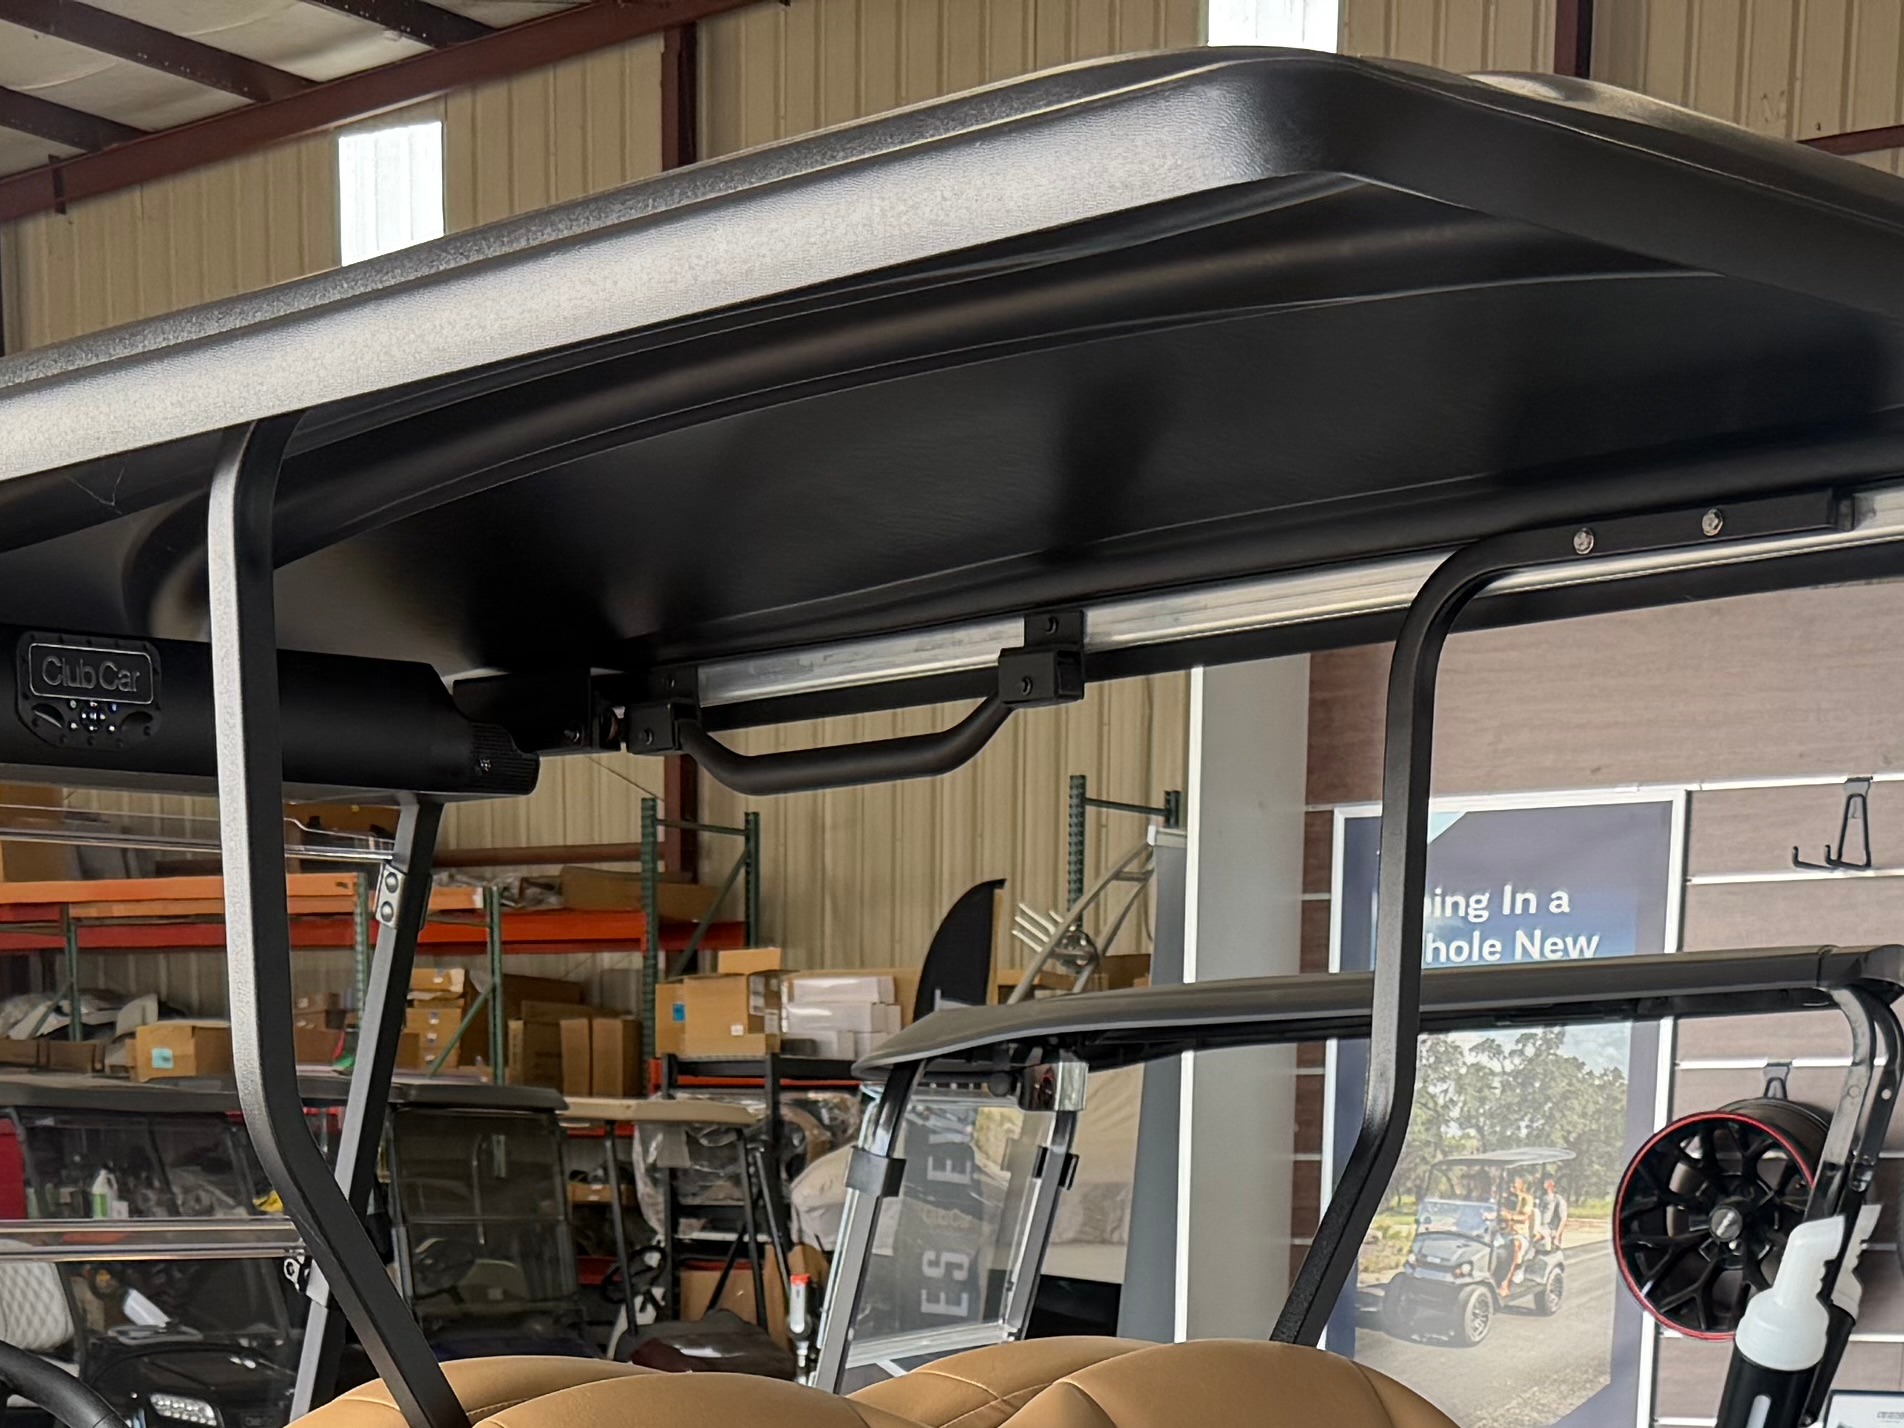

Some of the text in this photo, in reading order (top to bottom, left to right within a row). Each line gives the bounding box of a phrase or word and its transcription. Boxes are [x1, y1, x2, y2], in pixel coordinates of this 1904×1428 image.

[41, 655, 141, 692] Club Car
[1502, 884, 1537, 915] In
[1549, 889, 1571, 914] a
[1425, 929, 1600, 963] hole New
